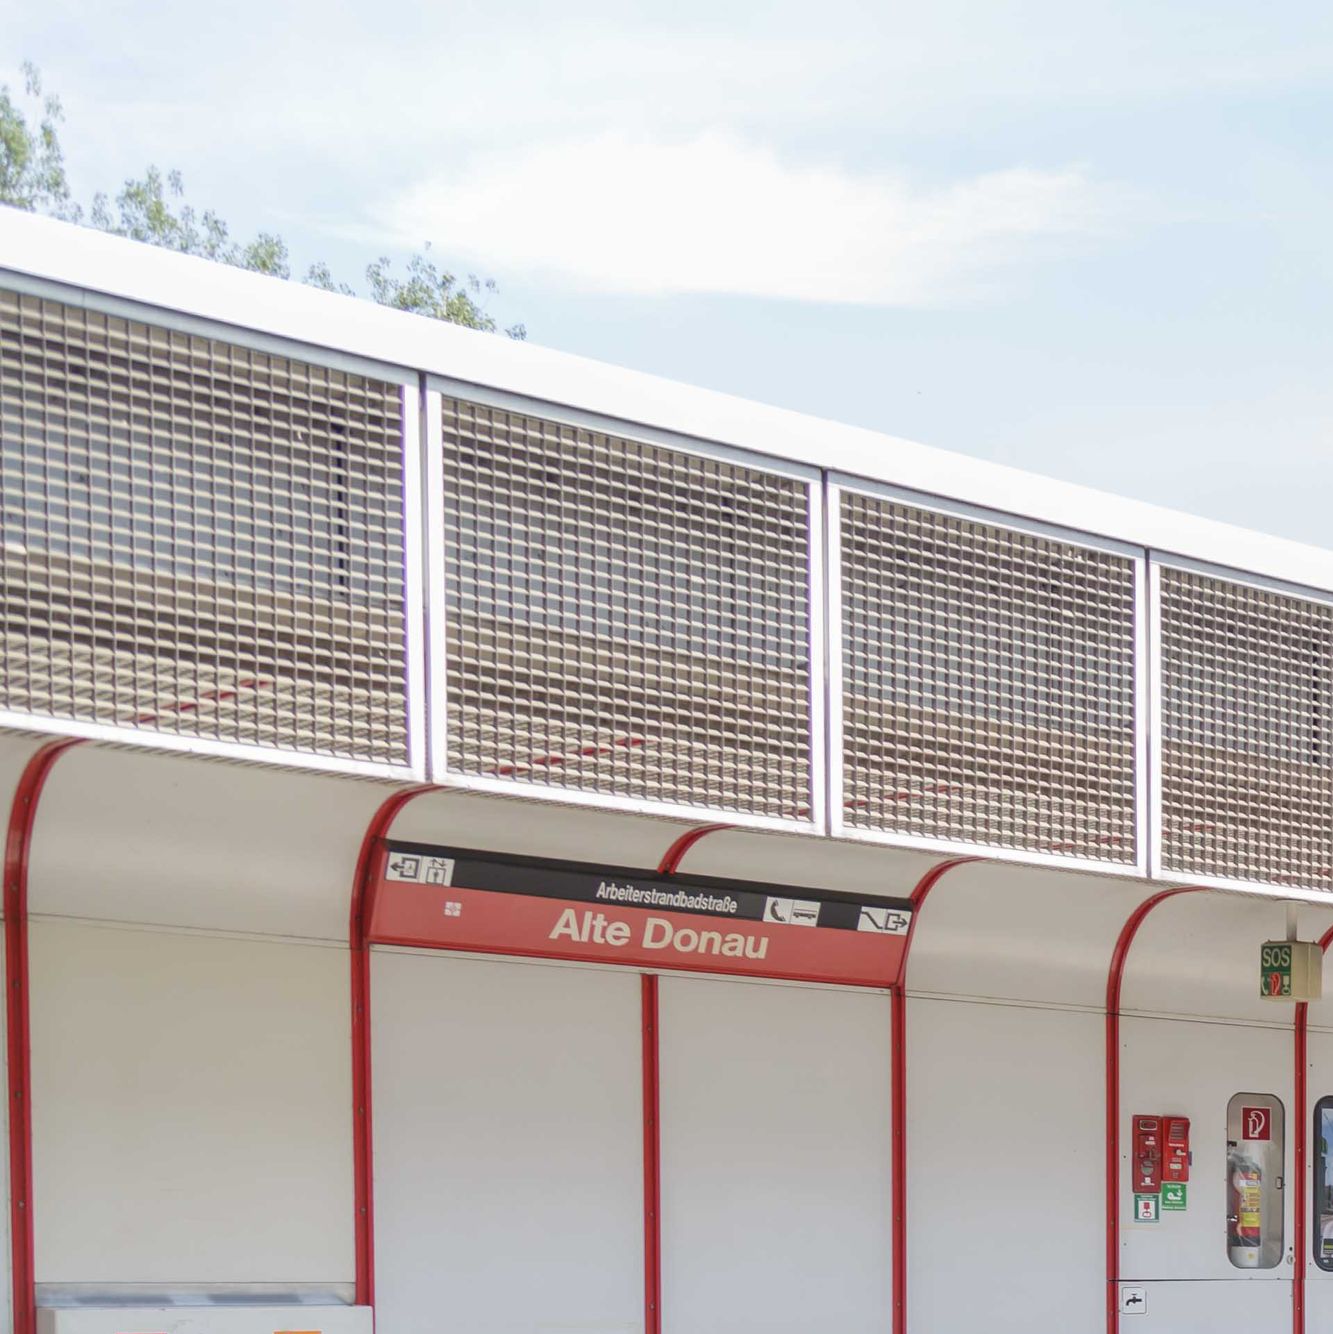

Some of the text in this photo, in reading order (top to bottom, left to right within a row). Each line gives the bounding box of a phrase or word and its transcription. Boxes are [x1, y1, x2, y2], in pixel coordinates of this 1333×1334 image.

[596, 881, 738, 913] Arbeiterstrandbadstraße
[549, 909, 769, 960] Alte Donau
[1262, 947, 1290, 967] SOS
